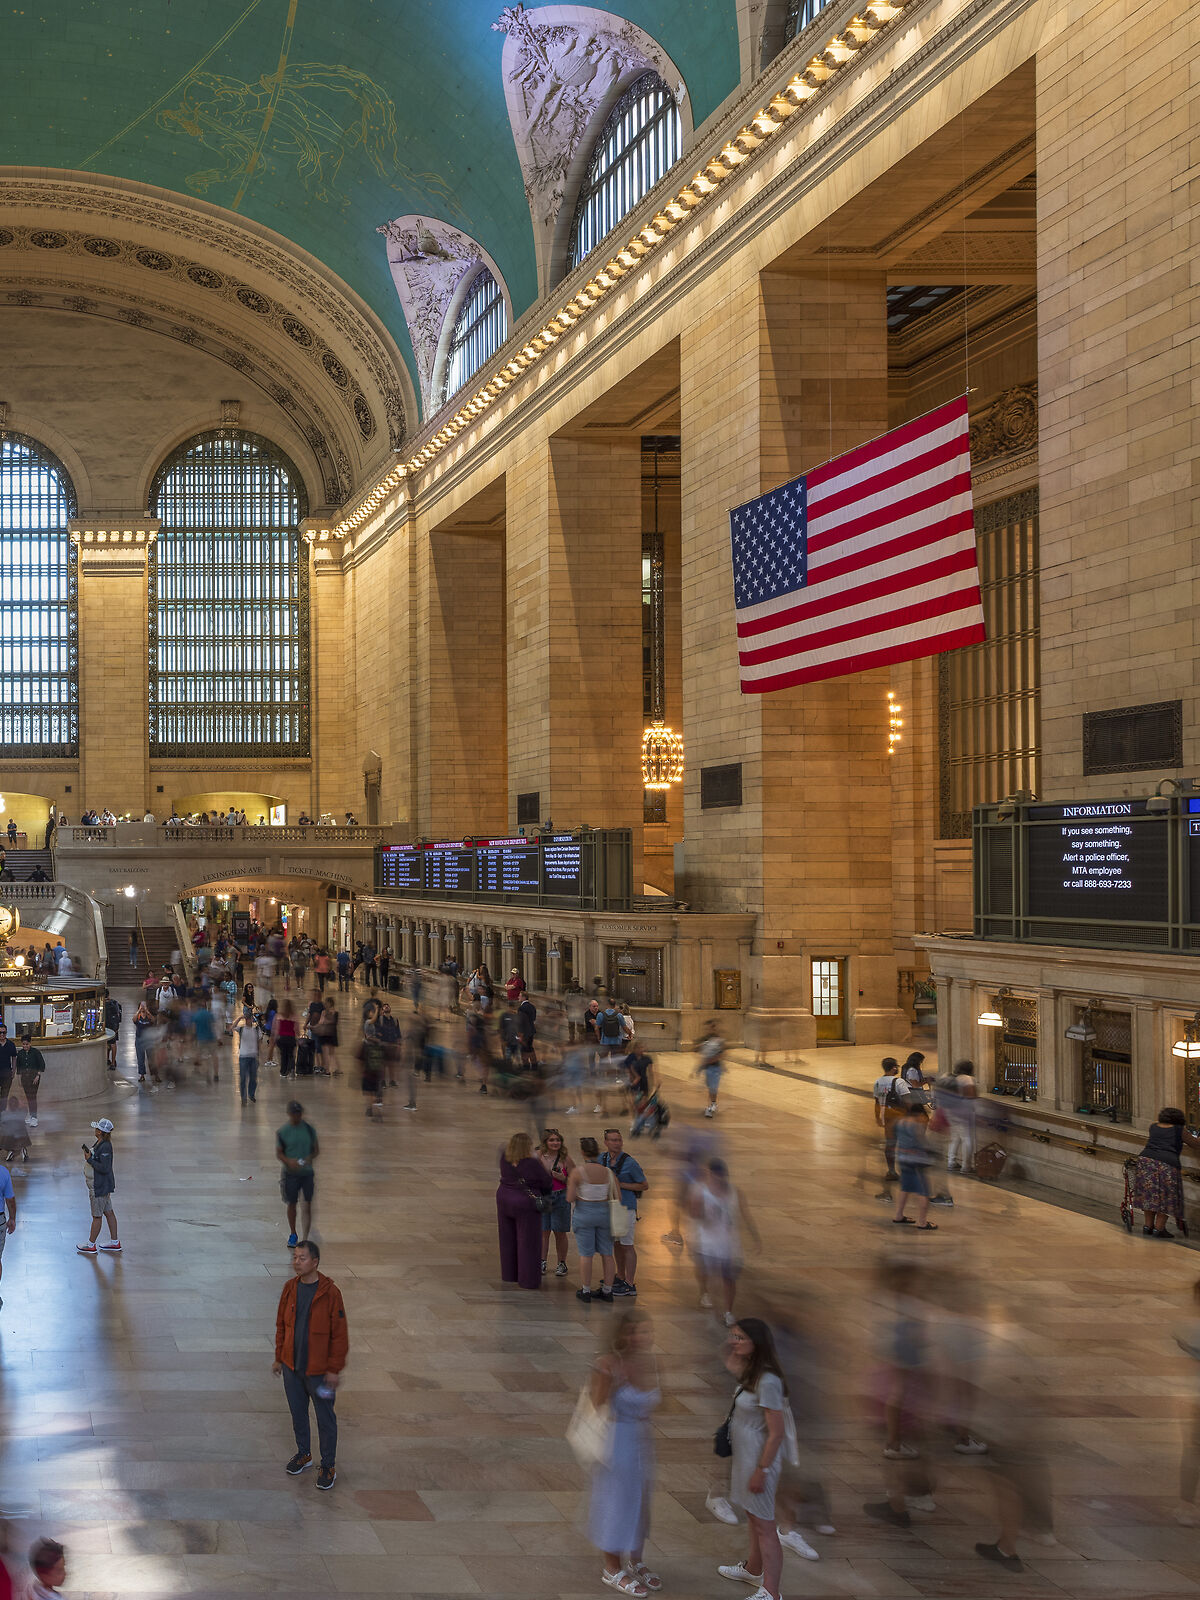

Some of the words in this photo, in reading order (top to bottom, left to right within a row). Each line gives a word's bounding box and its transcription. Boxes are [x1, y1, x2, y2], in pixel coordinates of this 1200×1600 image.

[1063, 804, 1131, 816] INFORMATION
[1068, 828, 1080, 836] you
[1094, 826, 1132, 835] something,
[1072, 841, 1084, 849] say
[1084, 840, 1121, 849] something.
[1085, 853, 1105, 862] police
[1106, 853, 1129, 862] officer,
[203, 867, 246, 881] LEXINGTON
[288, 866, 312, 874] TICKET
[314, 870, 352, 882] MACHINES
[1089, 867, 1121, 876] employee
[1084, 880, 1132, 888] 888-693-7233
